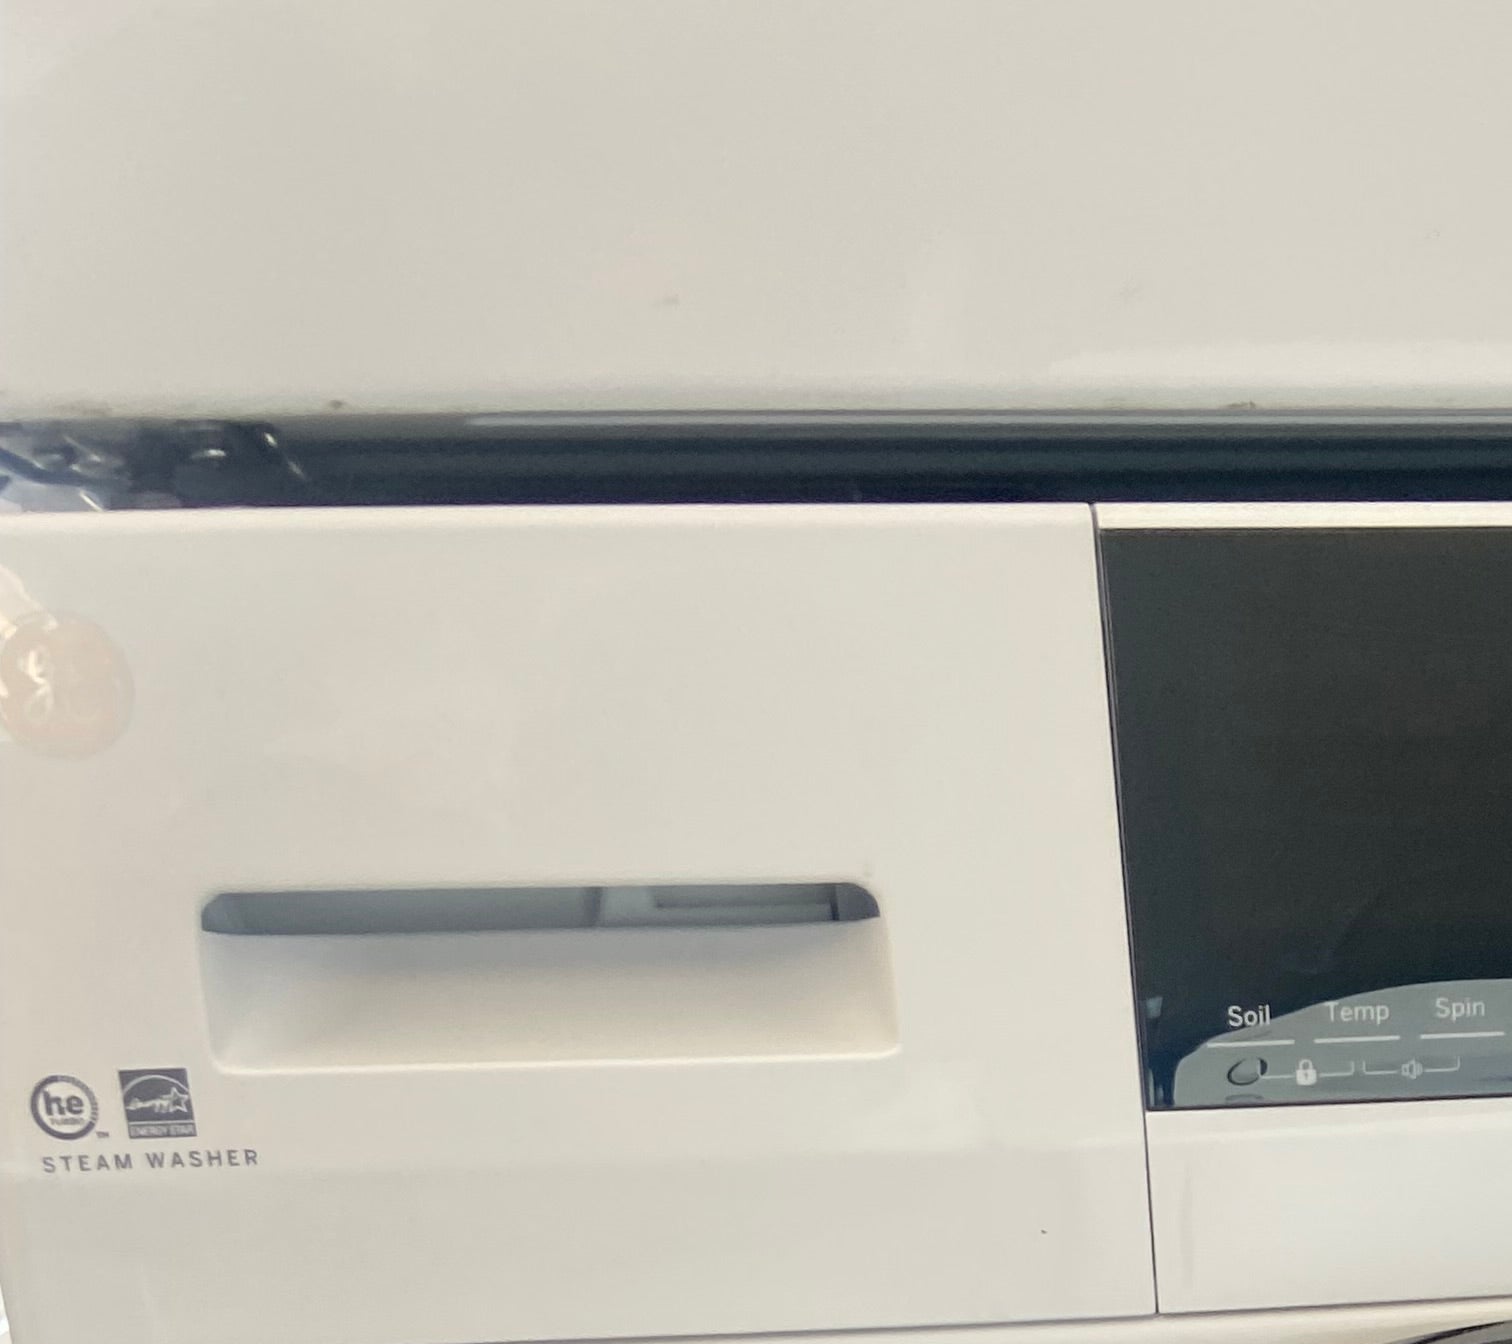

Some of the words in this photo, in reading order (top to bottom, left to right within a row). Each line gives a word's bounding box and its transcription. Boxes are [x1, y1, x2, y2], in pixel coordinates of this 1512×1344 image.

[1227, 1004, 1270, 1027] Soil
[1328, 1001, 1390, 1025] Temp
[1434, 995, 1485, 1020] Spin
[43, 1090, 84, 1115] he
[42, 1154, 133, 1173] STEAM
[146, 1150, 258, 1169] WASHER
